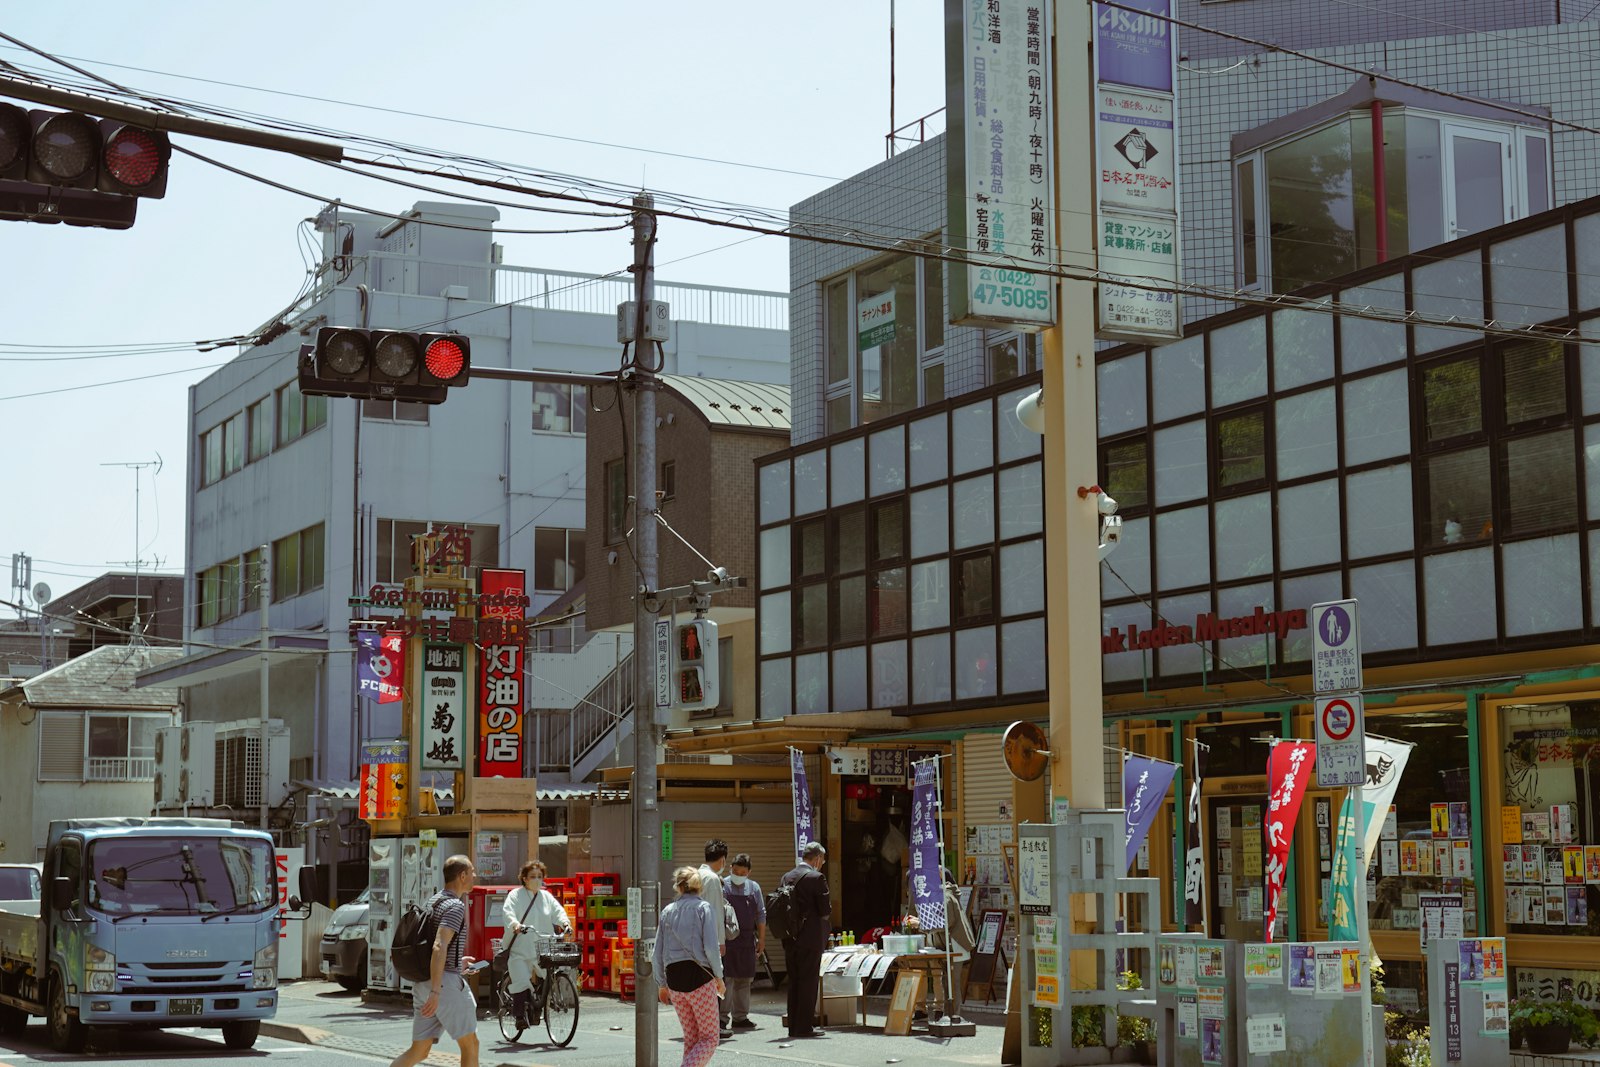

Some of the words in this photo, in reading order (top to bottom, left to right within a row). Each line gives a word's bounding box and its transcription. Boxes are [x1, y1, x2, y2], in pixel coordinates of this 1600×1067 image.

[1103, 170, 1172, 189] 日本名門酒会
[976, 207, 990, 251] 宅急便
[1030, 196, 1045, 257] 火曜定休
[1105, 222, 1172, 240] 貸室・マンション
[1104, 235, 1172, 255] 貸事務所・店舗
[994, 269, 1036, 287] (0422)
[973, 283, 1048, 310] 47-5085
[861, 301, 892, 322] テナント募集
[369, 583, 459, 607] Getränk
[467, 588, 531, 608] Laden
[1127, 619, 1193, 650] Laden
[1196, 607, 1308, 642] Masakiya
[426, 650, 461, 668] 地酒
[657, 624, 668, 704] 夜間押ボタン式
[360, 679, 400, 697] FC東京
[1319, 679, 1335, 690] この先
[1340, 676, 1357, 688] 30m
[485, 643, 520, 763] 灯油の店
[426, 702, 459, 764] 菊姫
[1323, 756, 1334, 768] 13
[1347, 755, 1357, 767] 17
[1322, 772, 1339, 784] この先
[1344, 771, 1361, 783] 30m
[798, 788, 811, 864] 多摩自
[912, 800, 931, 898] 多摩自慢
[1021, 840, 1048, 852] 柔道教室
[166, 949, 208, 958] ISUZU
[1448, 972, 1457, 1023] 下連雀一丁目
[1449, 1024, 1460, 1035] 13
